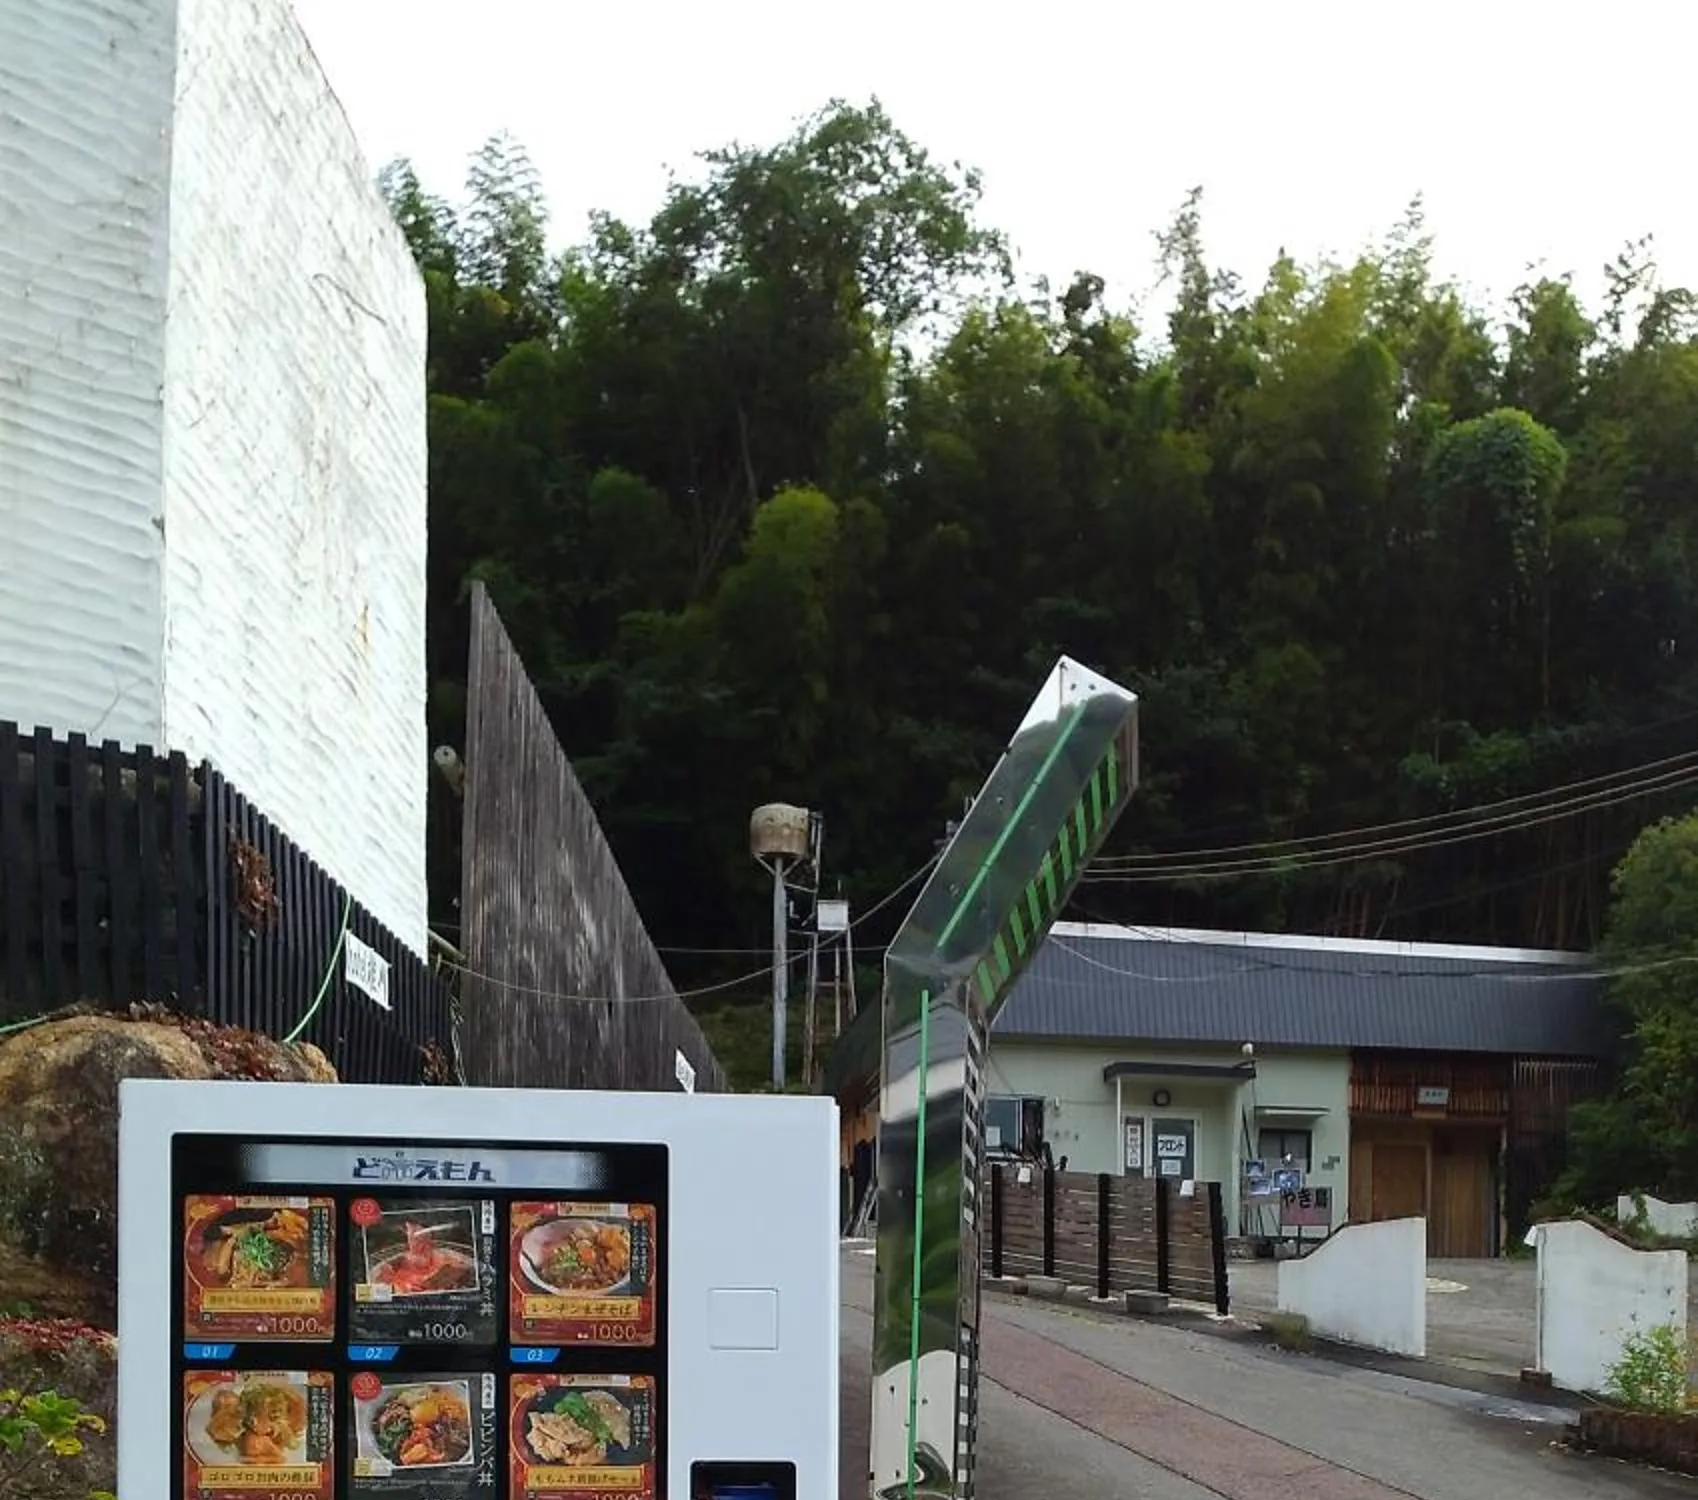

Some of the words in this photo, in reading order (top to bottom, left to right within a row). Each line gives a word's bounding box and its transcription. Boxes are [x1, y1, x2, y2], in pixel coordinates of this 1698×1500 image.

[1158, 1139, 1185, 1152] フロント
[202, 1346, 218, 1358] 01
[365, 1347, 383, 1360] 02
[527, 1349, 543, 1360] 03
